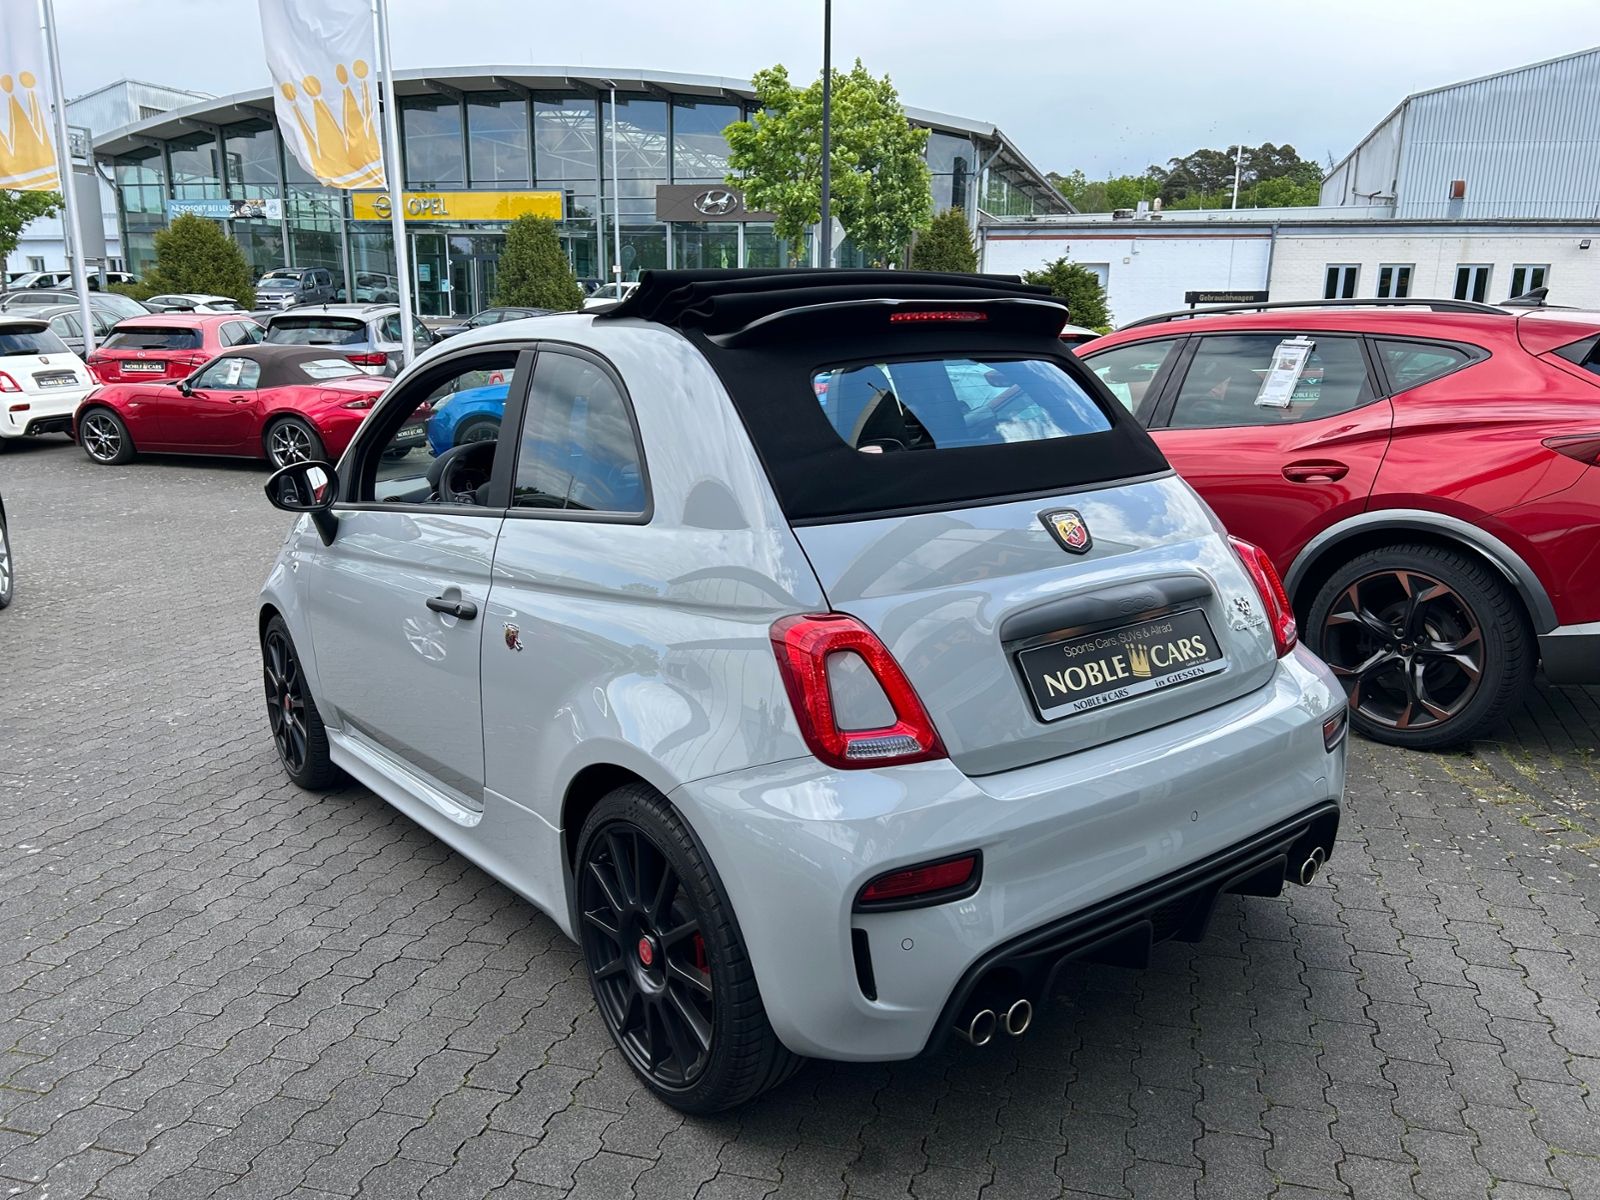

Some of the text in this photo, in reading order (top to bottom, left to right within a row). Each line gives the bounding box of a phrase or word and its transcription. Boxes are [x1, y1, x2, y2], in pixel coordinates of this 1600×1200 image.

[407, 198, 449, 215] OPEL
[1199, 293, 1254, 303] Gebrauchtwagen
[1064, 641, 1095, 658] Sports
[1119, 629, 1143, 644] SUVs
[1143, 628, 1150, 638] &
[1043, 635, 1207, 697] NOBLE CARS
[1155, 667, 1206, 688] in GIESSEN
[1074, 688, 1129, 711] NOBLE CARS
